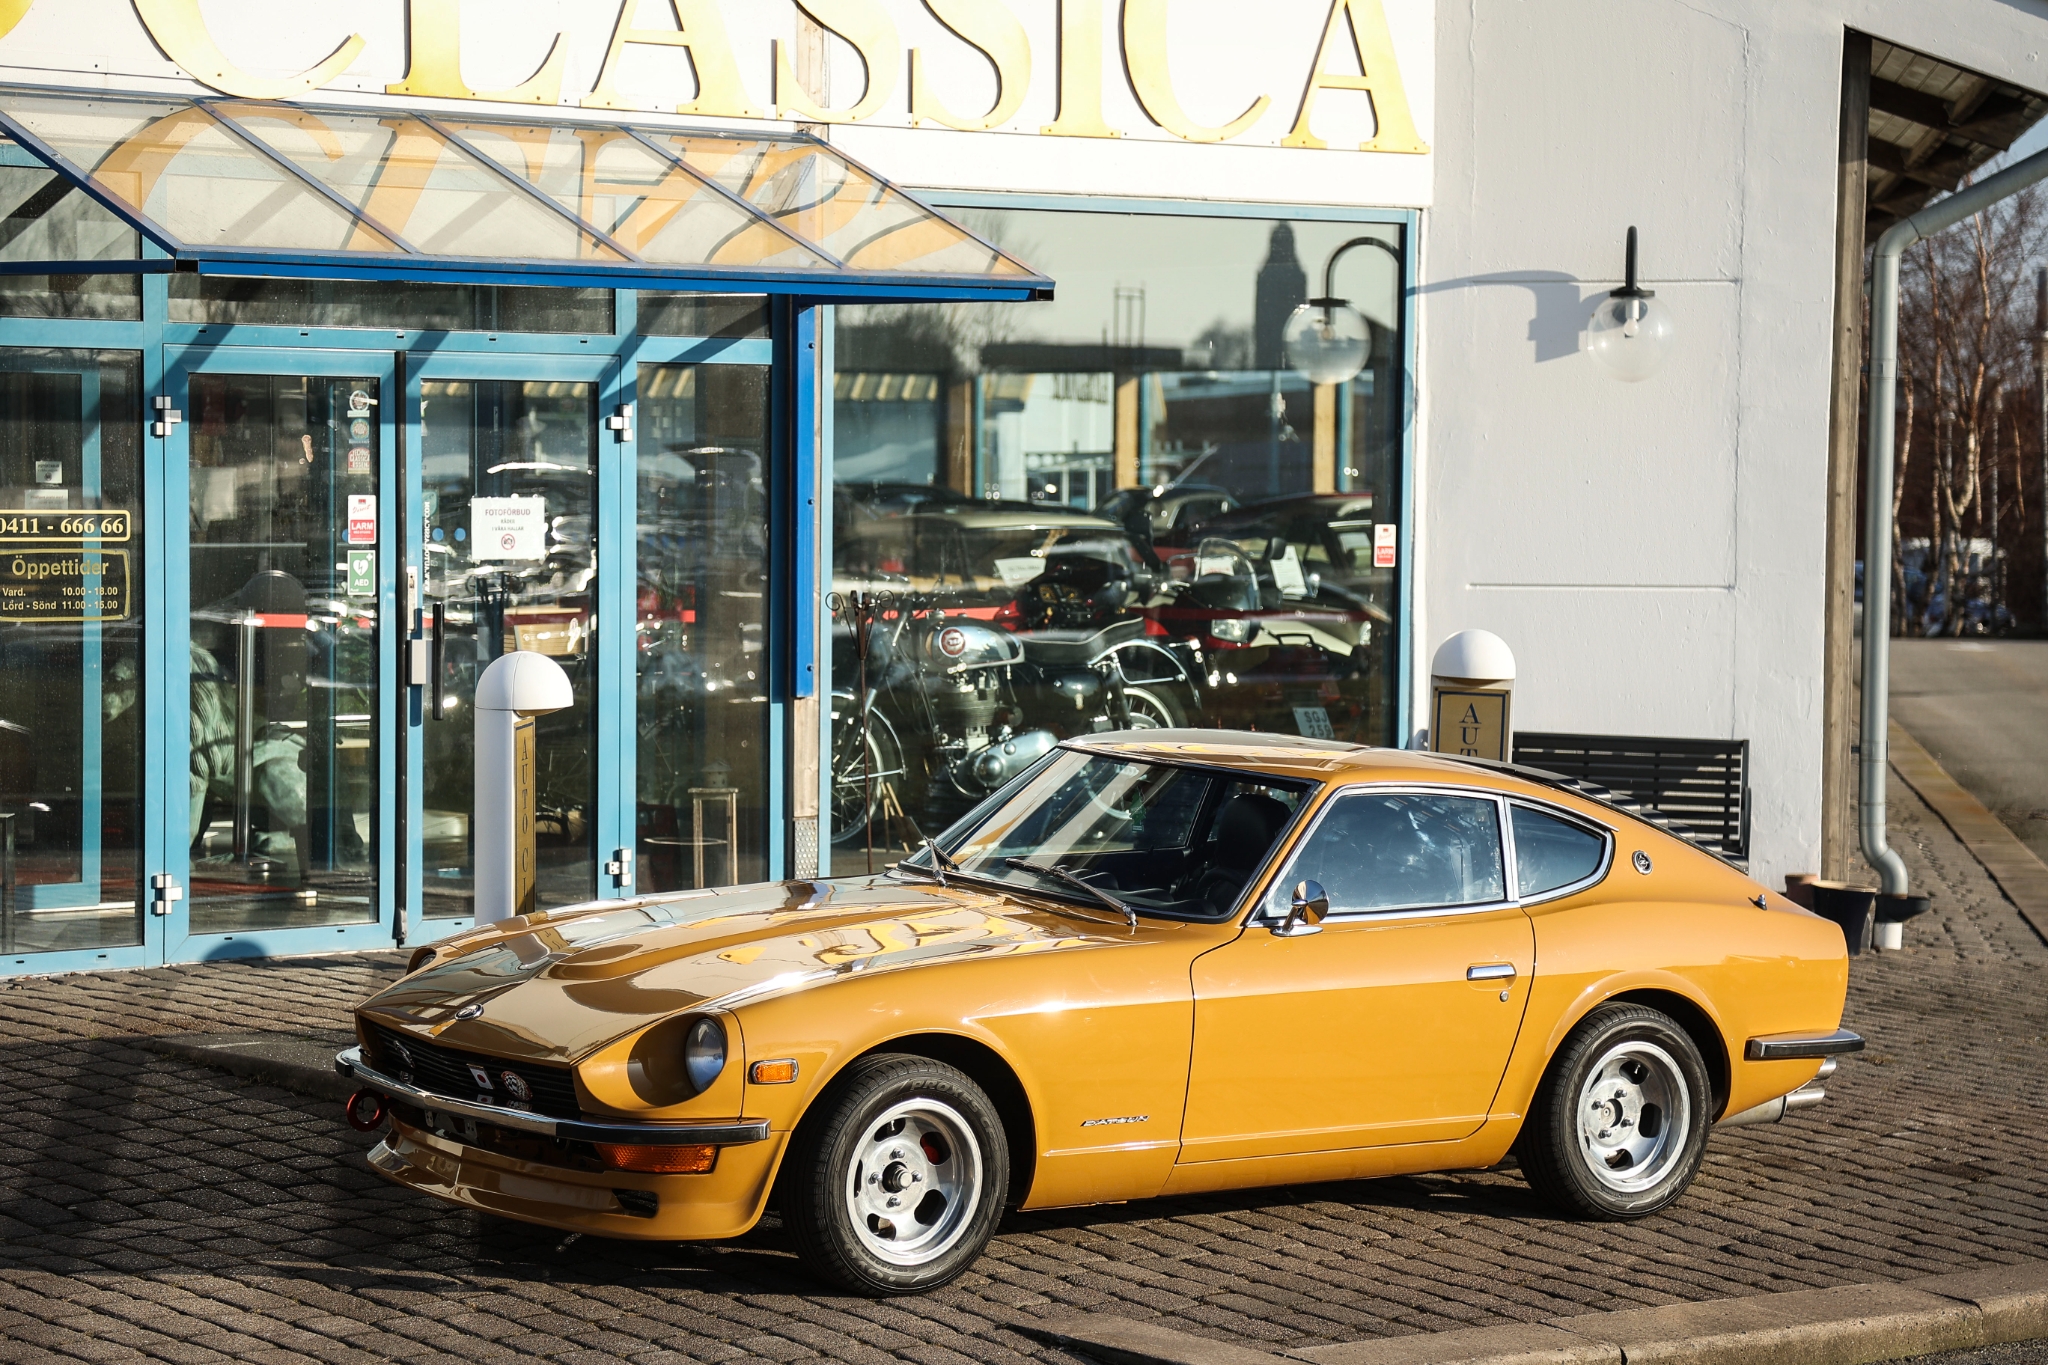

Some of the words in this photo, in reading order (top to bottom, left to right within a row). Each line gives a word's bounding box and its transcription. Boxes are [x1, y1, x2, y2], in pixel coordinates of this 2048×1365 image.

[485, 507, 531, 516] FOTOFÖRBUD
[60, 518, 95, 534] 666
[101, 518, 124, 534] 66
[351, 522, 373, 530] LARM
[1377, 547, 1394, 555] LARM
[11, 555, 109, 579] Öppettider
[2, 588, 26, 597] Vard.
[62, 587, 86, 596] 10.00
[94, 587, 118, 596] 18.00
[32, 601, 57, 610] Sönd
[62, 601, 86, 609] 11.00
[1304, 711, 1328, 723] SGJ
[1308, 724, 1333, 738] 259
[521, 736, 529, 835] AUTO
[910, 1078, 982, 1113] PROXES
[844, 1243, 897, 1285] TOYO
